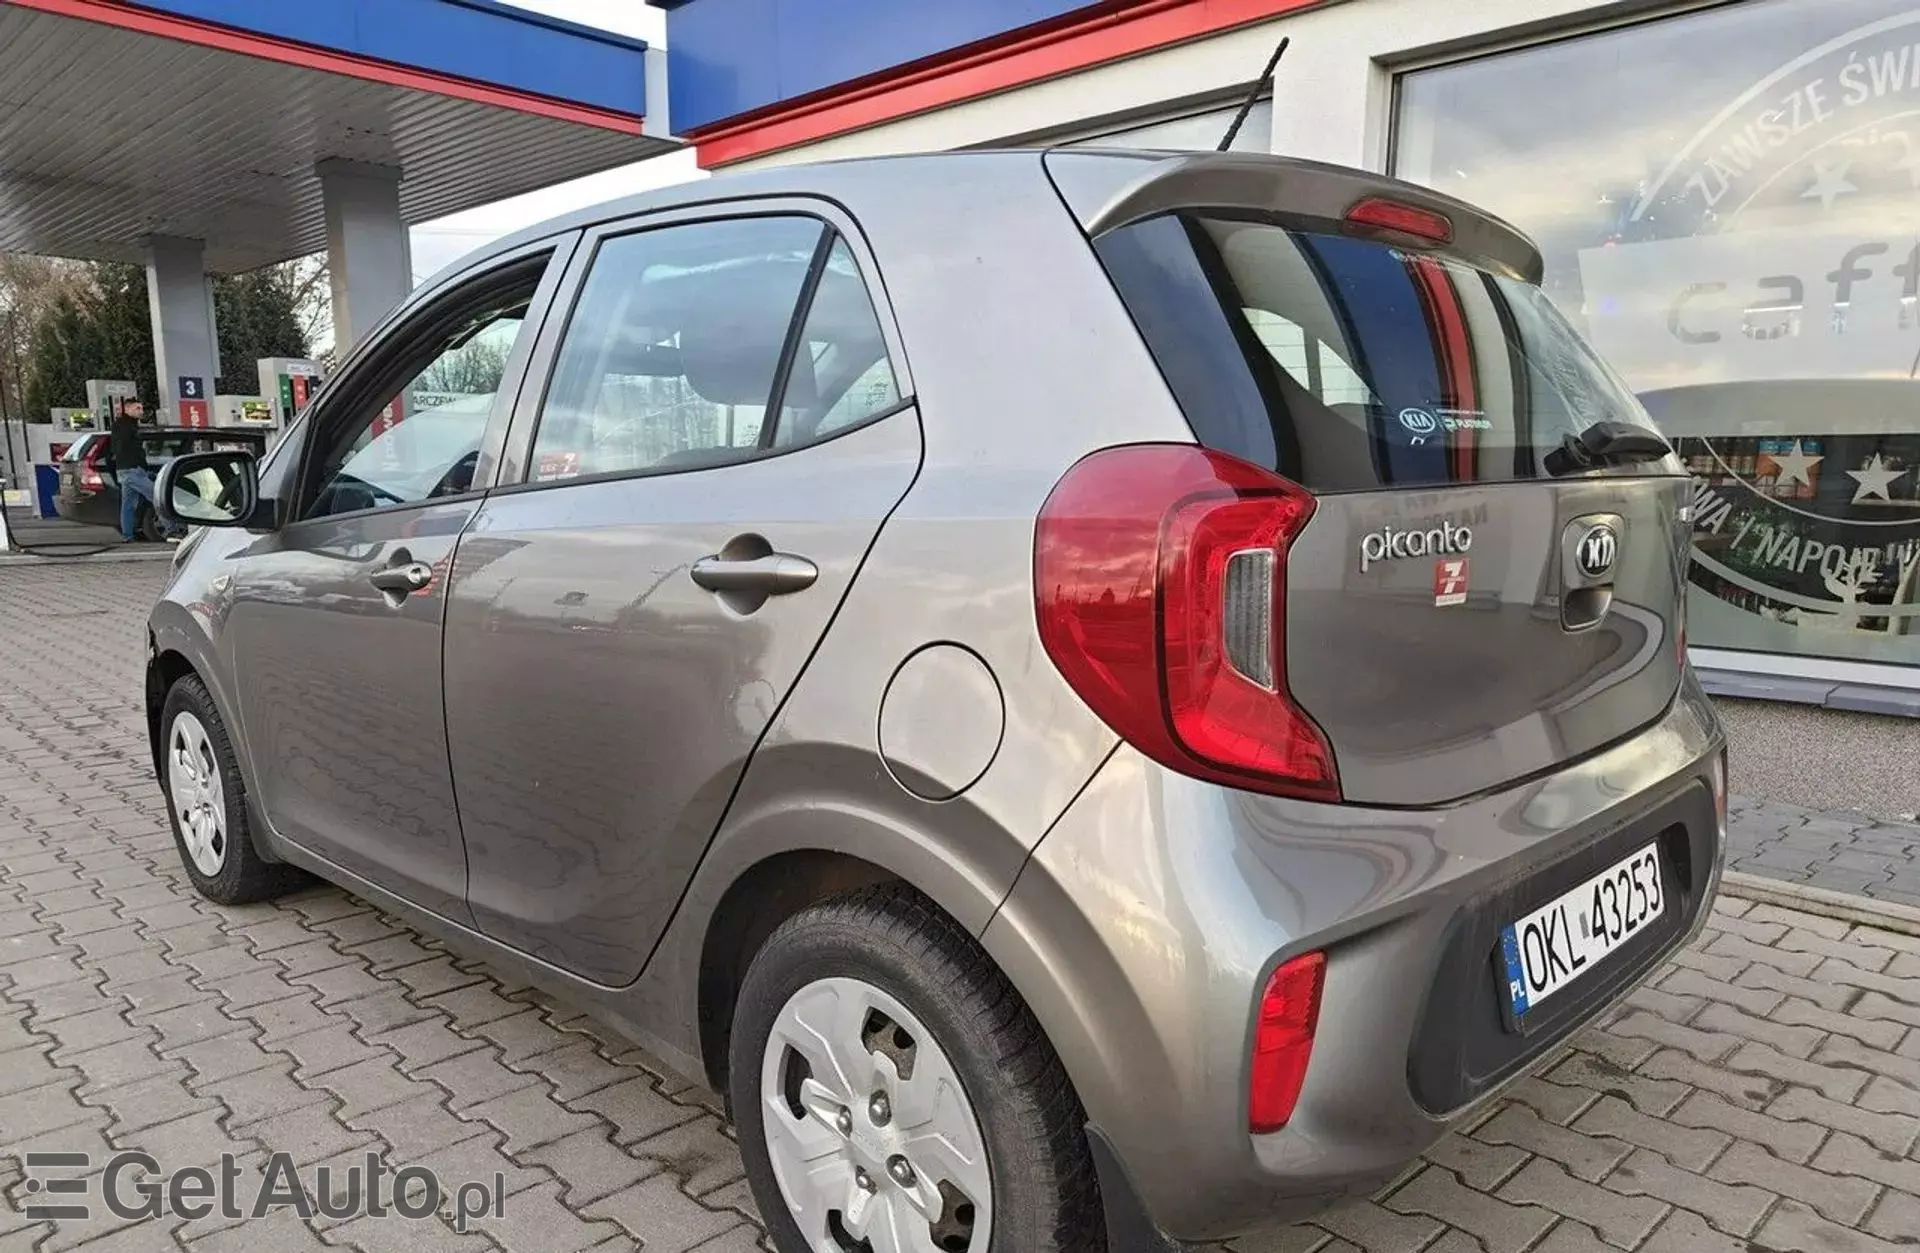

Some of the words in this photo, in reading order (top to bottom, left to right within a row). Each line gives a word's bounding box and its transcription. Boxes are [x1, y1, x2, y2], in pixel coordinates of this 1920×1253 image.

[1683, 77, 1834, 207] ZAWSZE
[185, 380, 197, 396] 3
[1403, 413, 1432, 428] KIA
[1361, 519, 1473, 574] picanto
[1586, 534, 1616, 569] KIA
[1522, 904, 1587, 993] OKL
[1591, 852, 1660, 948] 43253
[1509, 978, 1526, 1002] PL
